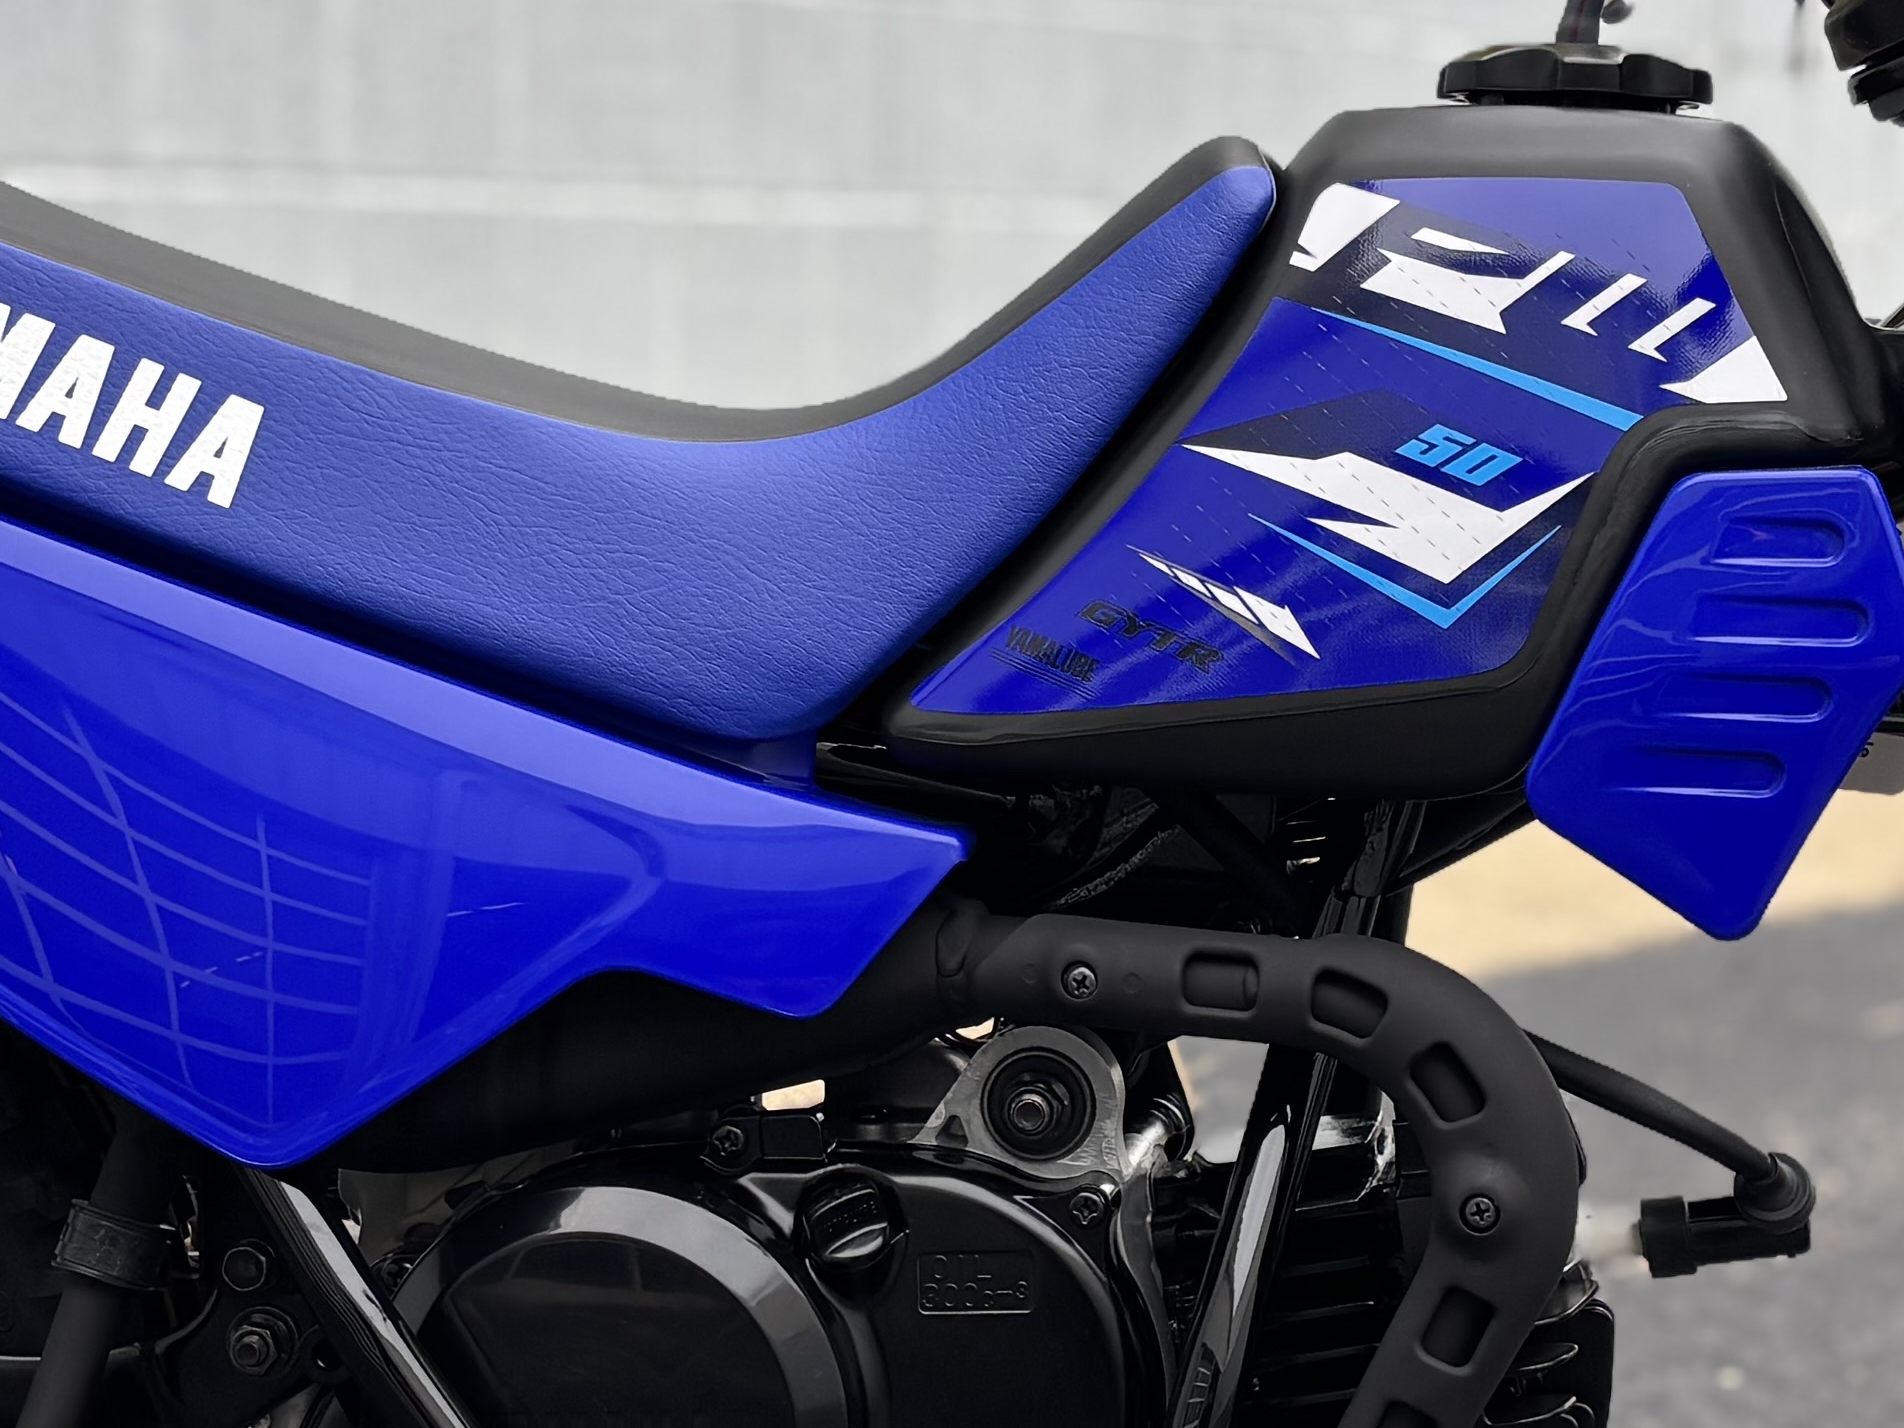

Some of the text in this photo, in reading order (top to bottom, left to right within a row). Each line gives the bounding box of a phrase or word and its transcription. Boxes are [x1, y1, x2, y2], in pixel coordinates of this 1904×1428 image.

[1393, 423, 1523, 486] 50
[1077, 600, 1224, 673] GYTR
[931, 1254, 993, 1279] OIL
